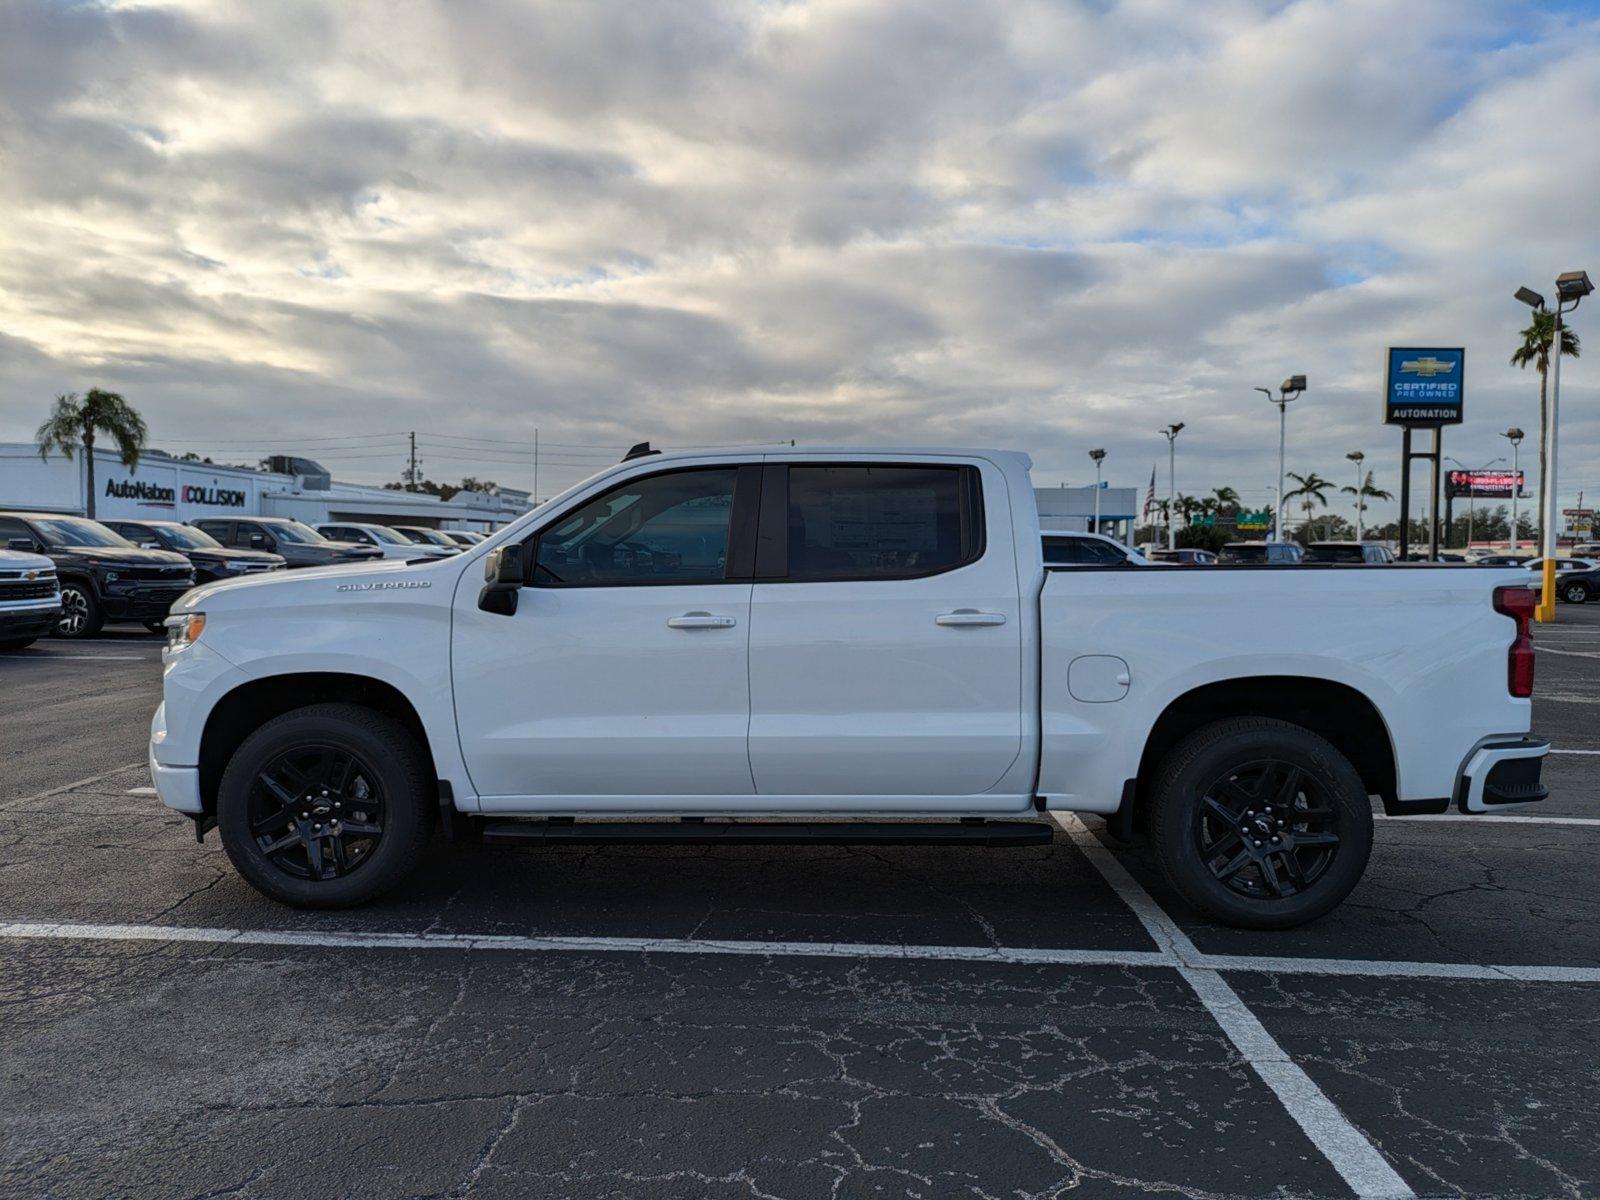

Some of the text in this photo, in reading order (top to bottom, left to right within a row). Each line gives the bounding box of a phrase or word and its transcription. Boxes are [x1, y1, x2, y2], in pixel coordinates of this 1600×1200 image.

[1418, 390, 1455, 398] OWNED
[1393, 408, 1457, 418] AUTONATION
[105, 478, 246, 507] AutoNation COLLISION
[336, 580, 432, 592] SILVERADO
